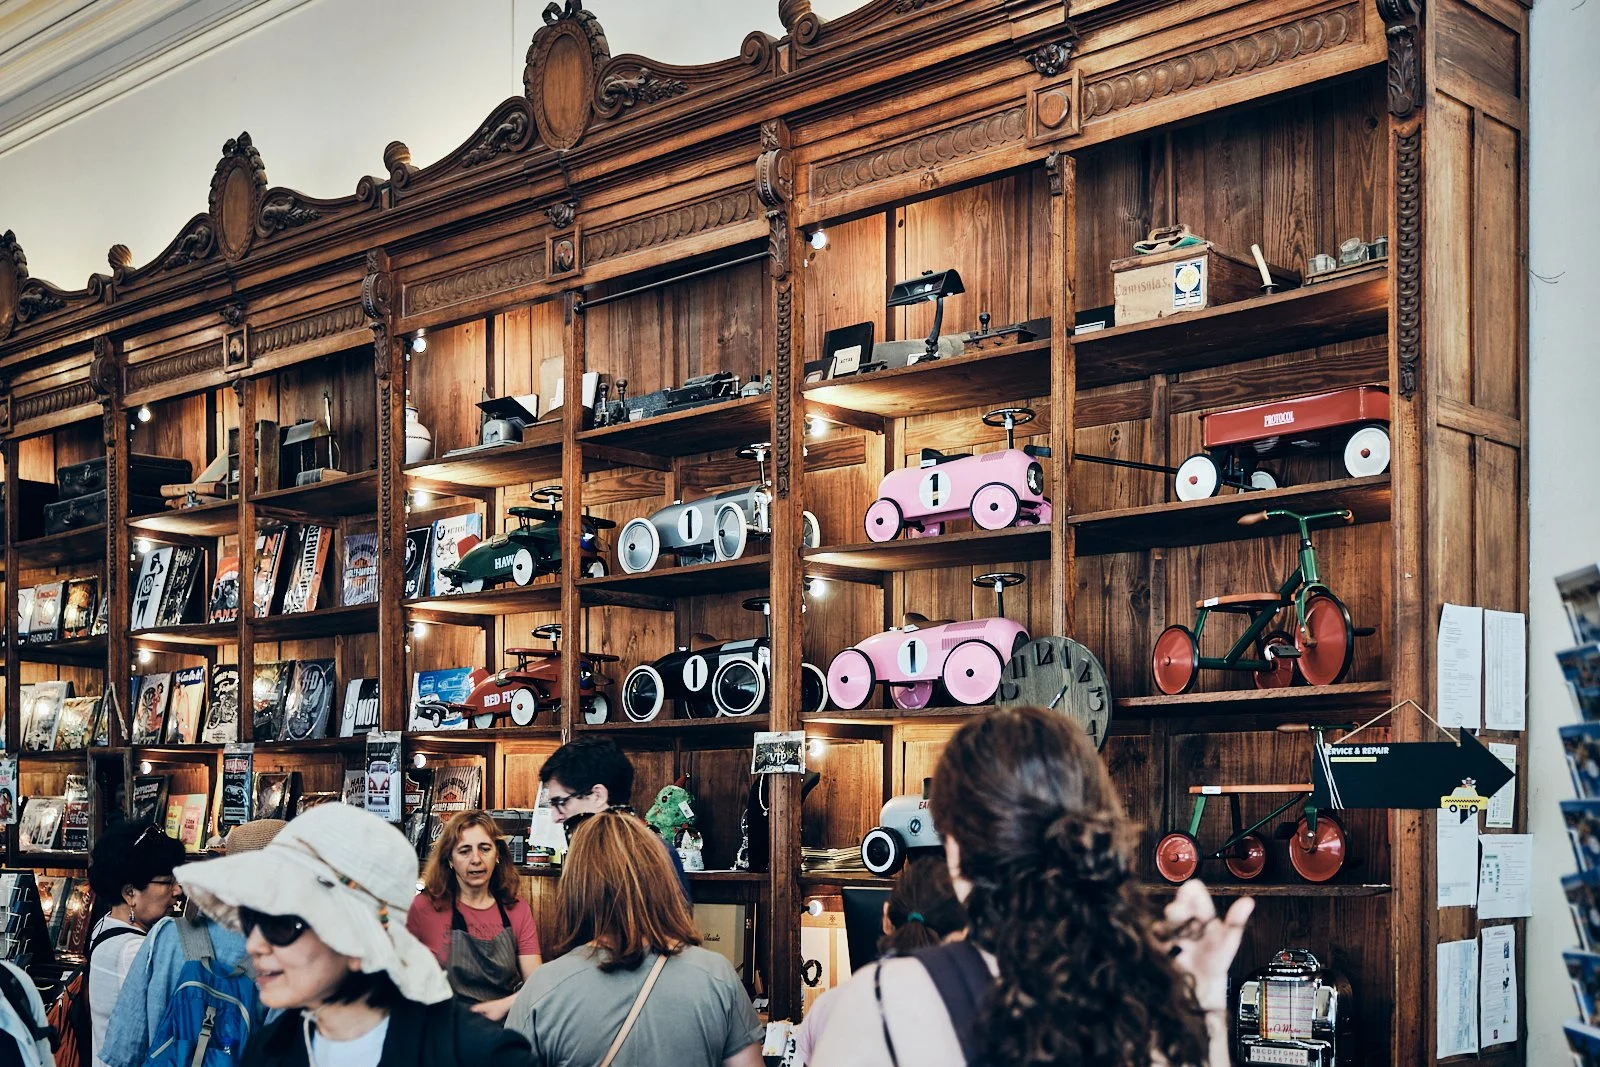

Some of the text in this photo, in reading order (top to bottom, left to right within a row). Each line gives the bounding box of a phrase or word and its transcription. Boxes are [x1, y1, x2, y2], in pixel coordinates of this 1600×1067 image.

[1264, 410, 1295, 428] PROTOCOL
[929, 473, 939, 506] 1
[685, 509, 693, 540] 1
[209, 607, 239, 620] LANZ
[906, 640, 917, 674] 1
[690, 657, 698, 689] 1
[355, 698, 379, 727] MOT
[484, 694, 500, 708] RED
[1087, 686, 1104, 713] 3
[1354, 747, 1361, 756] &
[1361, 746, 1390, 755] REPAIR
